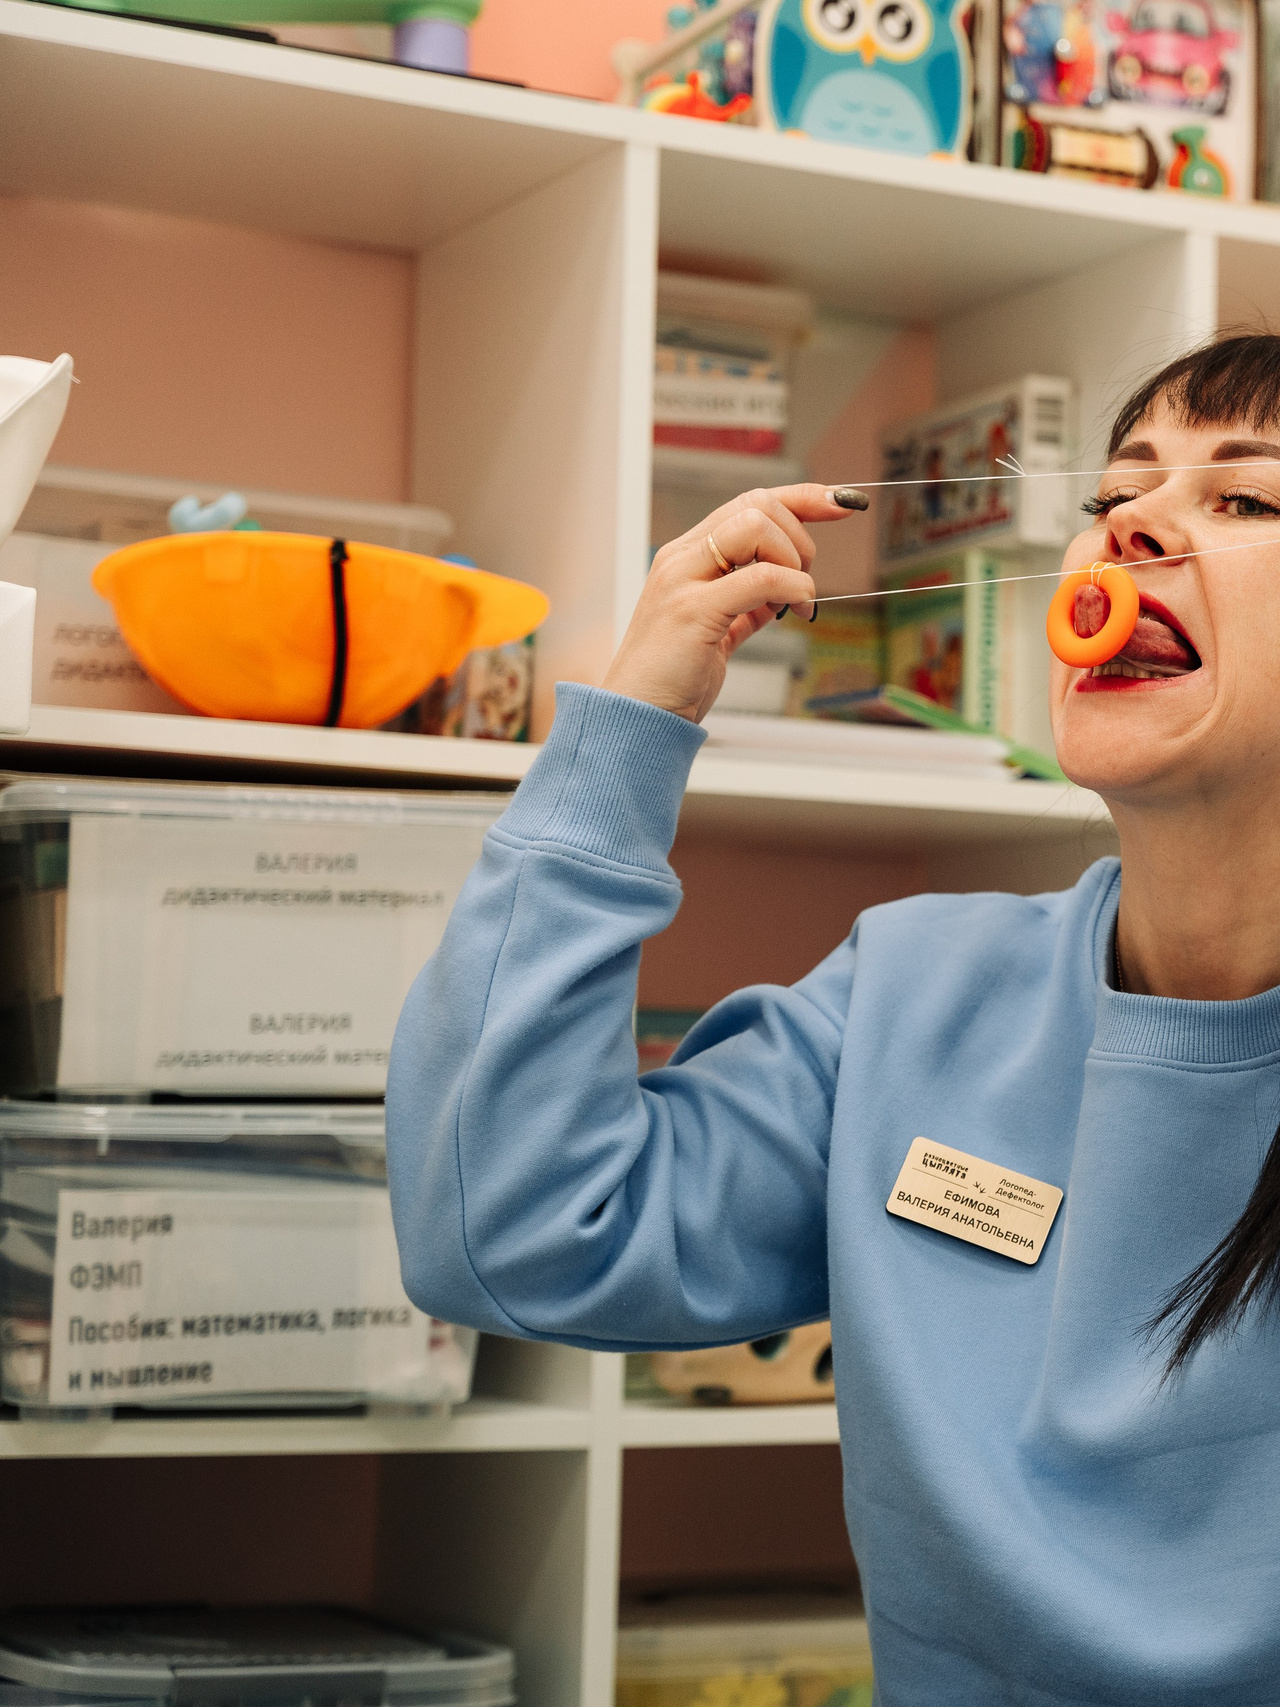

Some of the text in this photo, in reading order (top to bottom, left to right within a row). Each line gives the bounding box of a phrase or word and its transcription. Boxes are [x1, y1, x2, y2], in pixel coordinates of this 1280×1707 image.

[256, 853, 358, 874] ВАЛЕРИЯ
[162, 886, 444, 911] дидактический материал
[250, 1013, 352, 1034] ВАЛЕРИЯ
[156, 1045, 327, 1069] дидактический
[995, 1187, 1045, 1211] Дефектолог
[999, 1178, 1037, 1198] Логопед-
[943, 1189, 1001, 1219] ЕФИМОВА
[71, 1211, 173, 1243] Валерия
[896, 1190, 1034, 1249] ВАЛЕРИЯ АНАТОЛЬЕВНА
[69, 1261, 142, 1291] ФЭМП
[68, 1306, 412, 1345] Пособия: математика, логика
[90, 1361, 214, 1388] мышление
